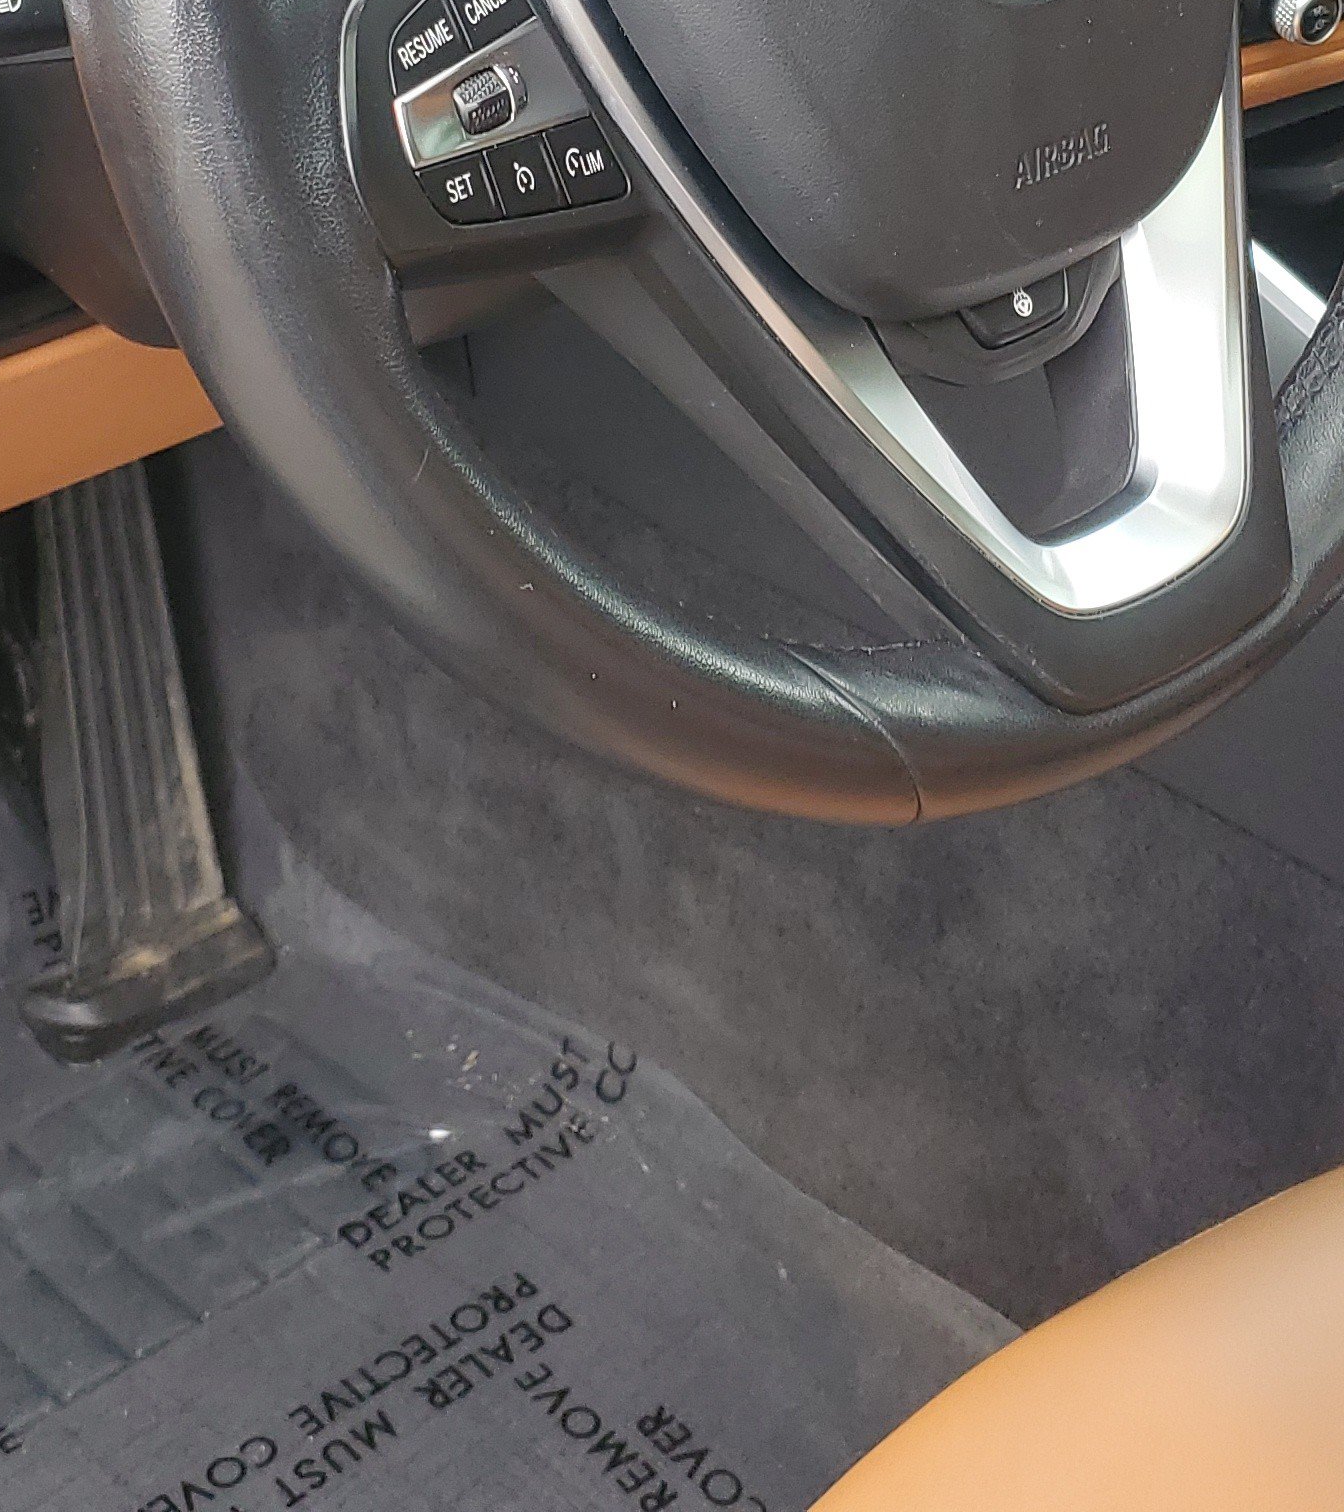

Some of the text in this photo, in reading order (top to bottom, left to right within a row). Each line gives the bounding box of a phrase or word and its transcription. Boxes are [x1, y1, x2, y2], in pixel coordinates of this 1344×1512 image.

[396, 17, 454, 71] RESUME
[445, 172, 476, 204] SET
[581, 149, 605, 176] LIM
[1013, 122, 1112, 190] AIRBAG
[337, 1037, 591, 1248] DEALER MUST
[367, 1113, 596, 1273] PROTECTIVE
[276, 1303, 574, 1508] DEALER MUST
[287, 1272, 539, 1437] PROTECTIVE
[514, 1362, 678, 1512] REMOVE
